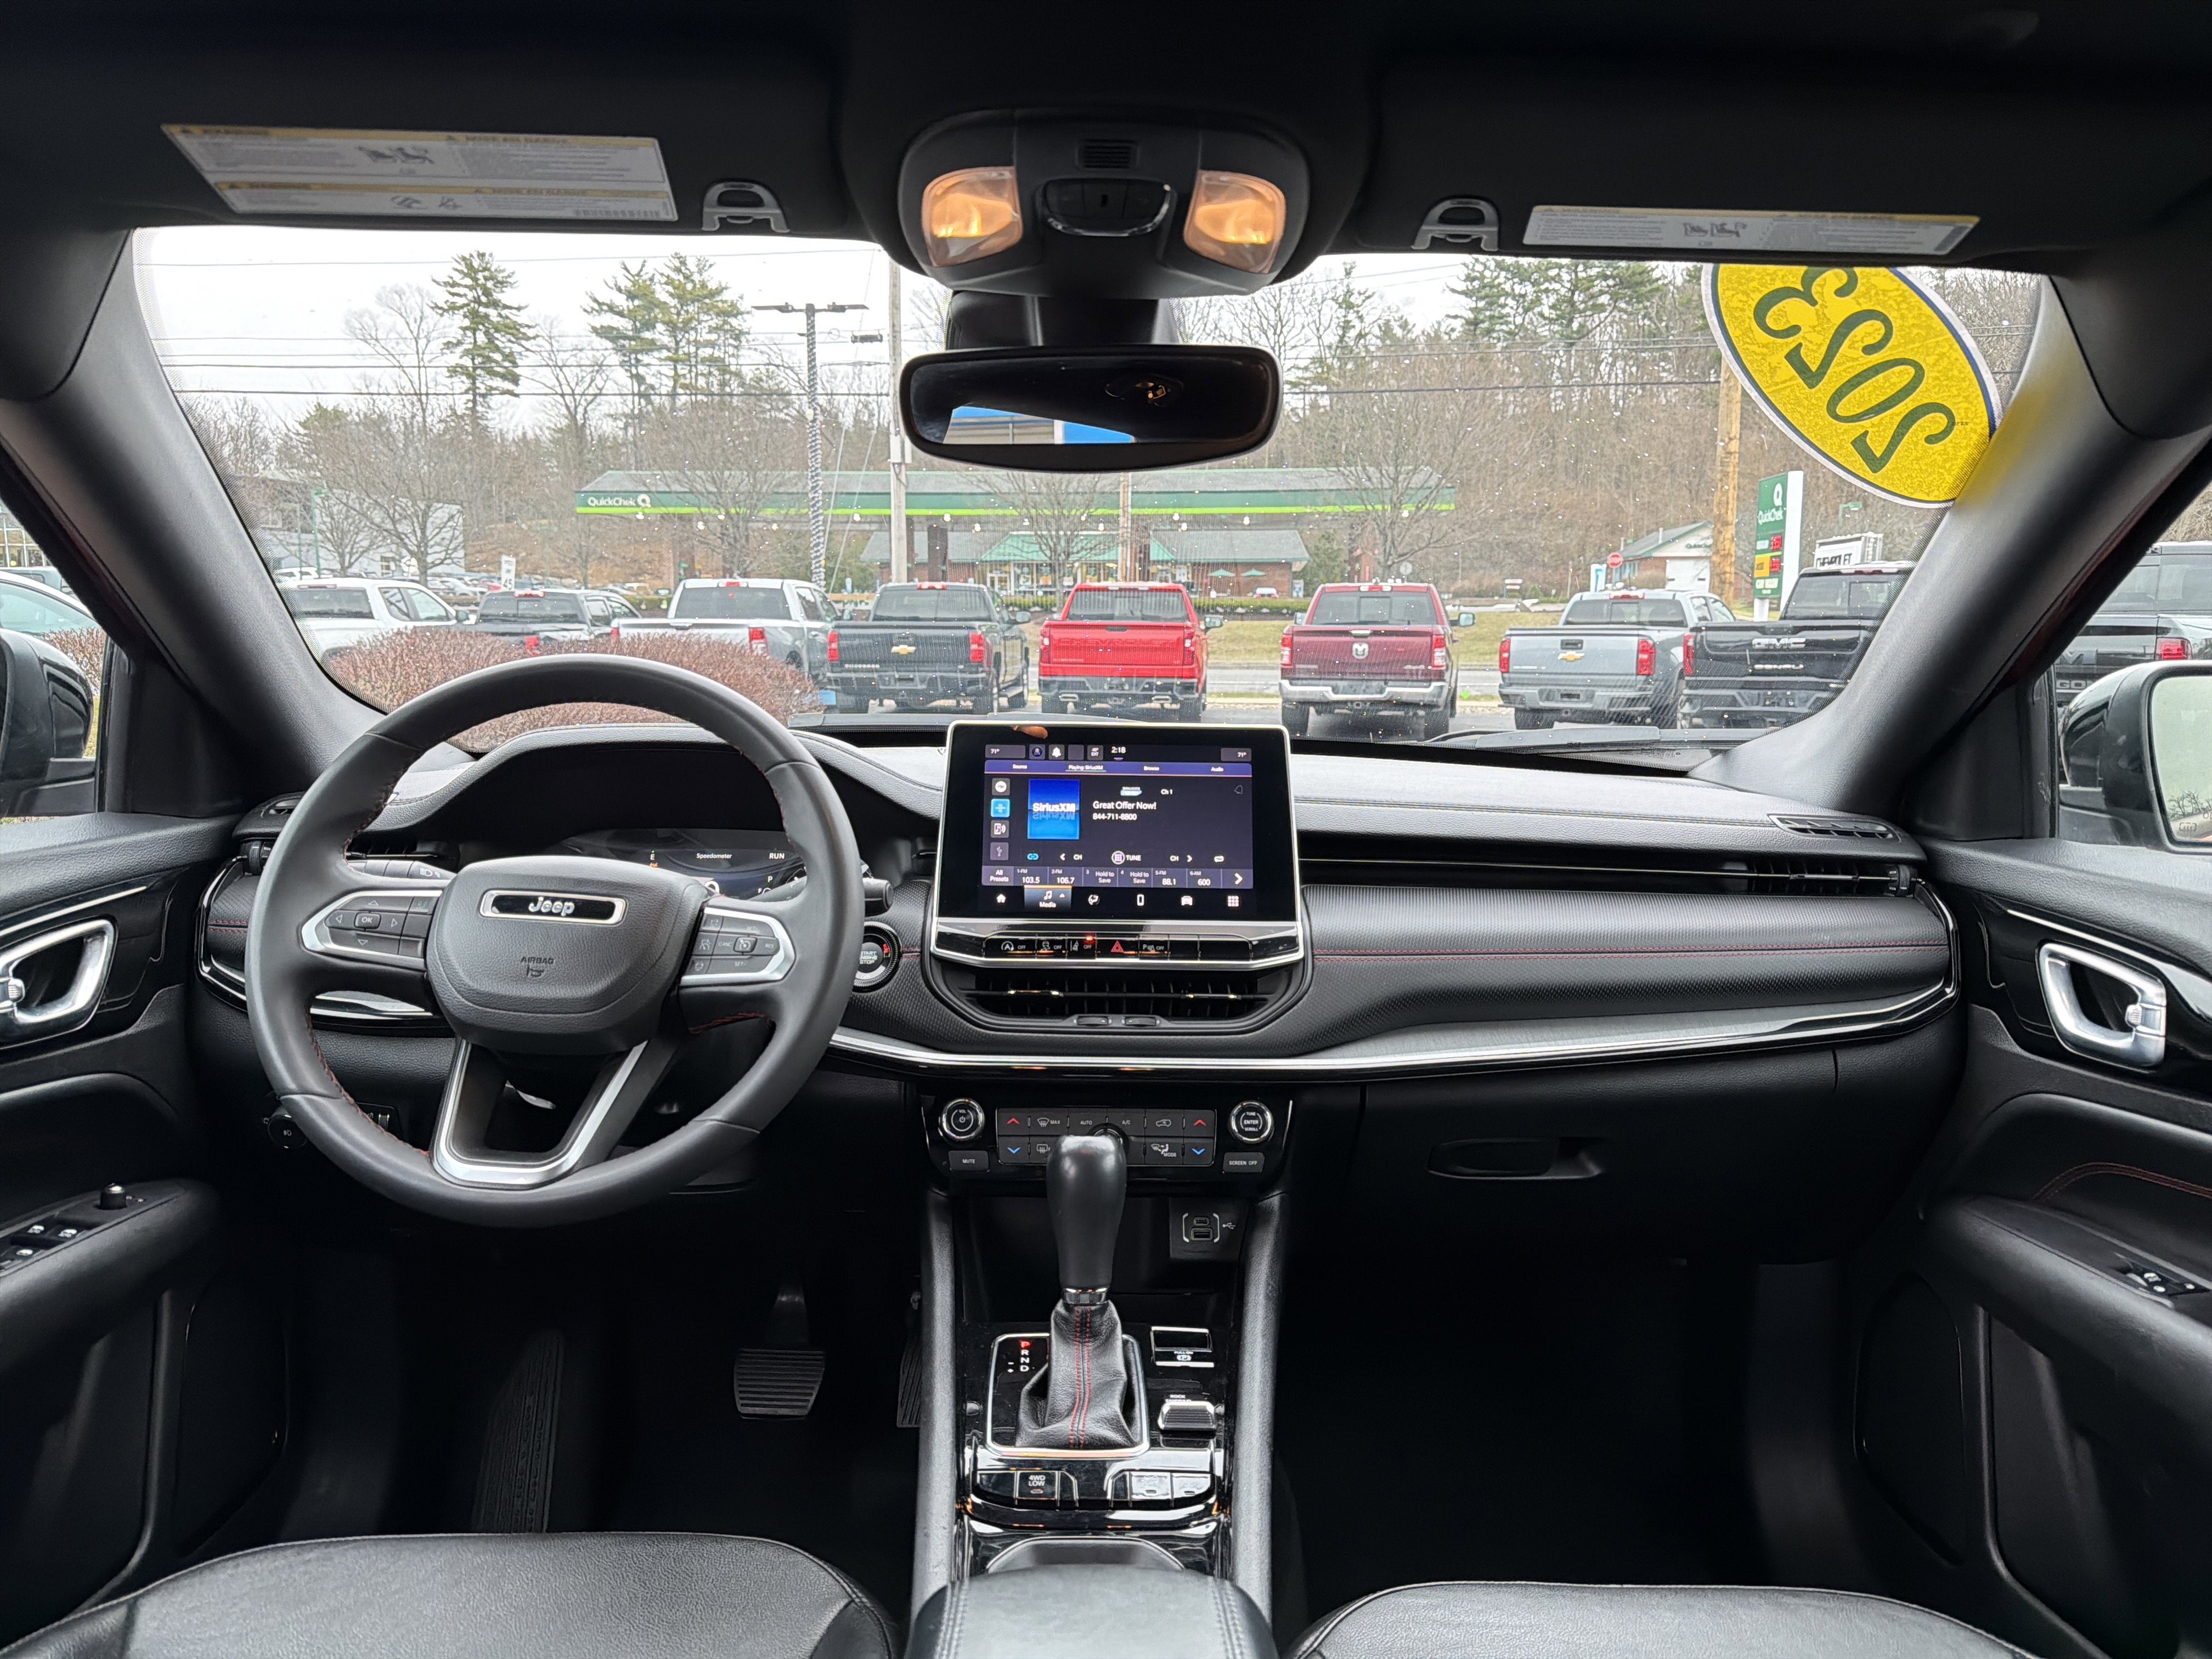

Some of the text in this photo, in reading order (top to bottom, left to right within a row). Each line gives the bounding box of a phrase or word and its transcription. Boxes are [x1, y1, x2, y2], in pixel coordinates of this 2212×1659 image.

[503, 578, 512, 590] 45
[1752, 637, 1806, 648] GMC
[1032, 802, 1076, 812] SiriusXM
[1093, 801, 1157, 810] Great Offer Now!
[528, 896, 575, 916] Jeep
[521, 956, 554, 964] AIRBAG
